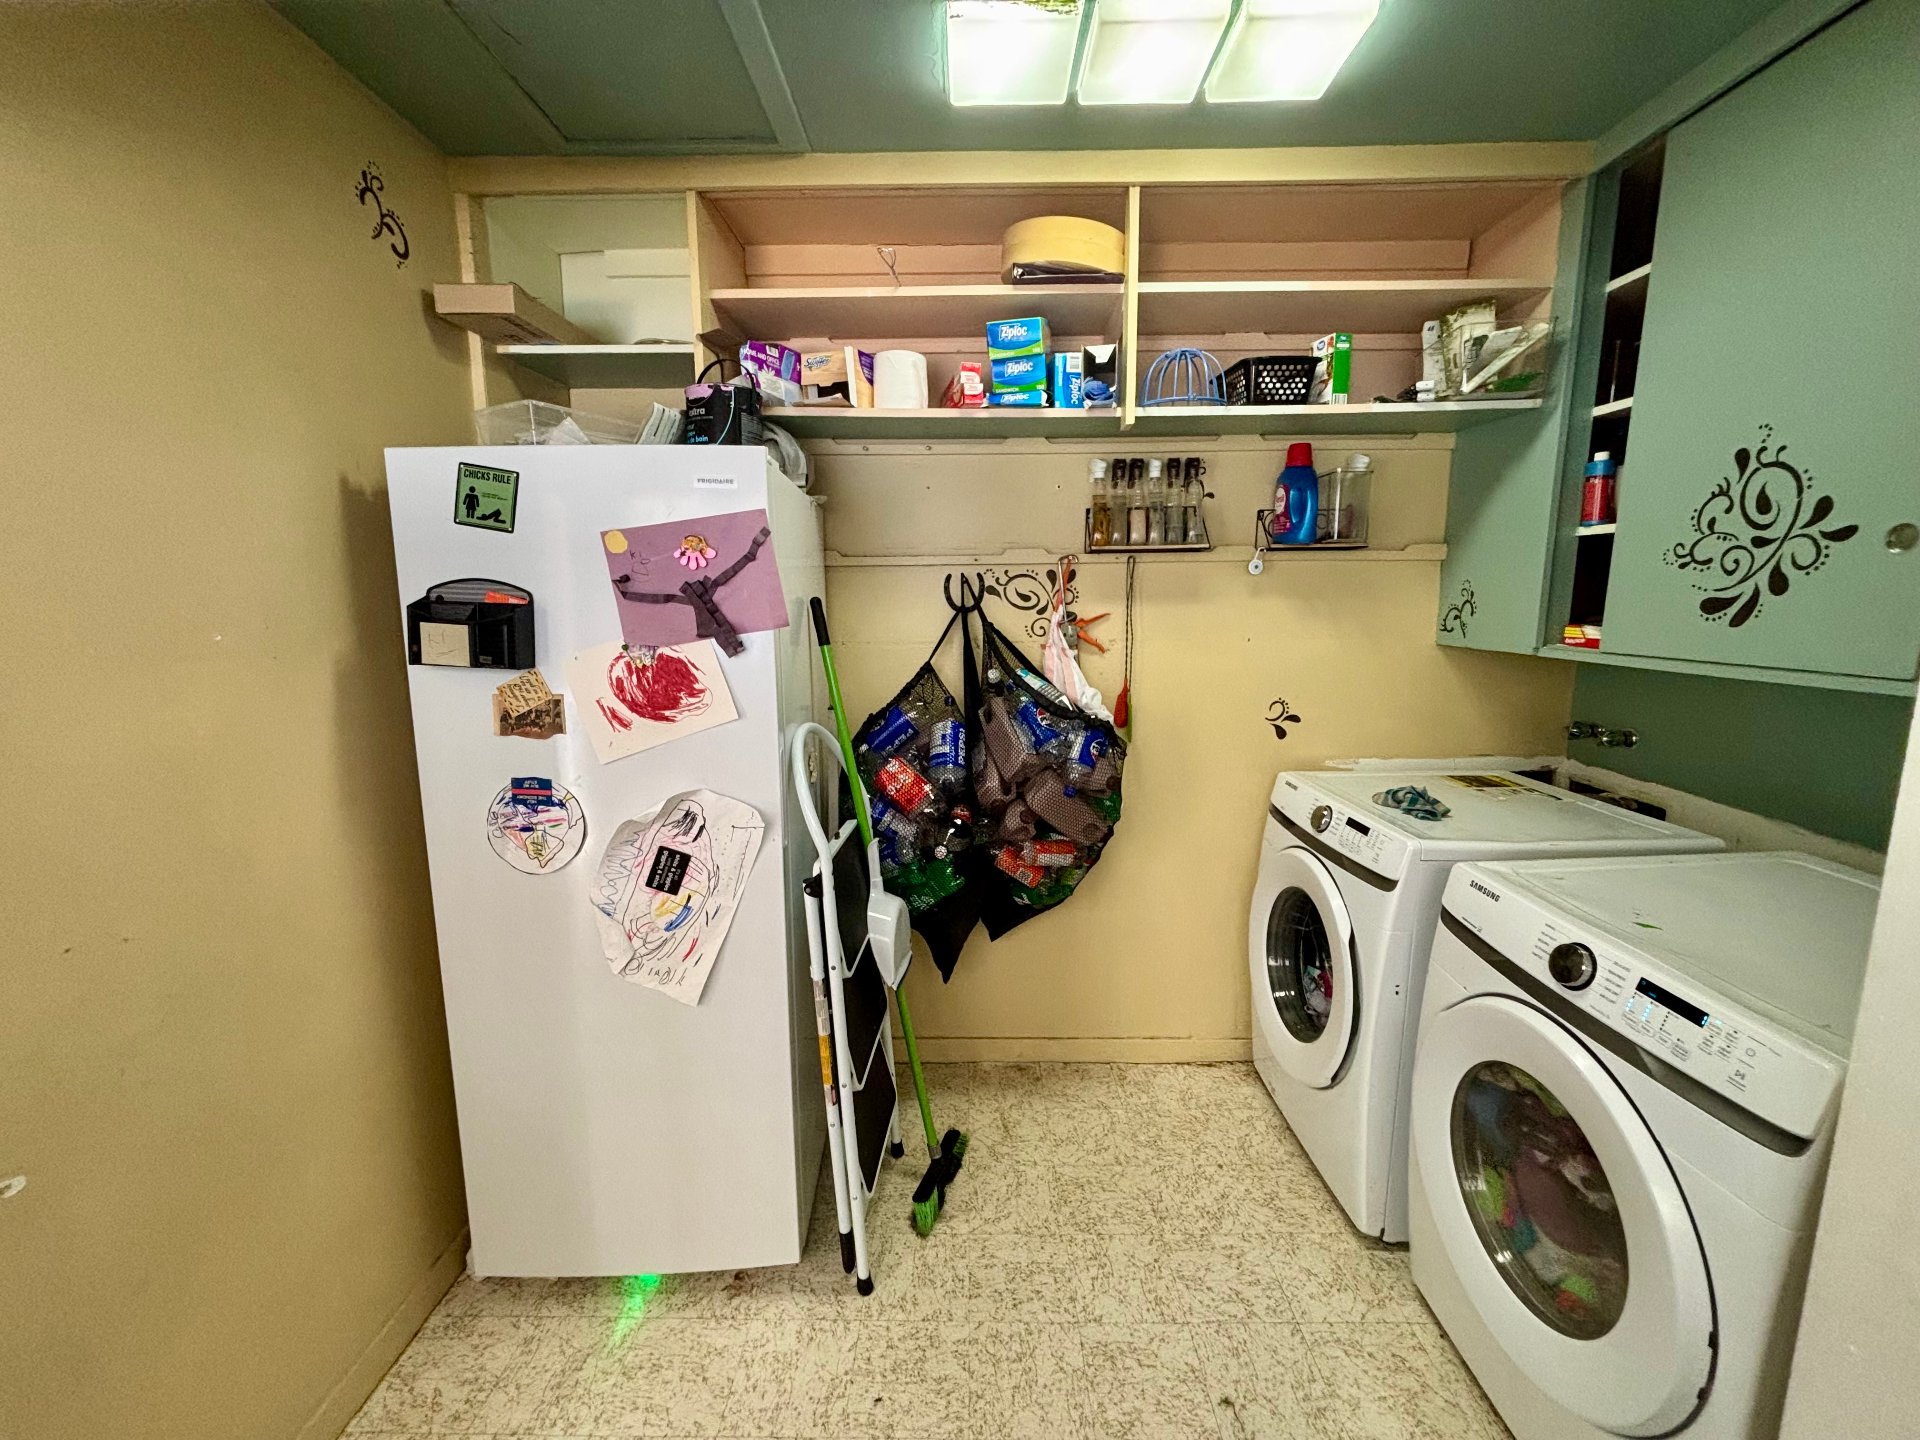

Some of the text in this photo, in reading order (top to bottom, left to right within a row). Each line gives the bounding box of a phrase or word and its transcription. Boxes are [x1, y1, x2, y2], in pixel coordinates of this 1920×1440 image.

[1001, 323, 1028, 340] Ziploc
[1006, 361, 1034, 376] Ziploc
[1002, 392, 1030, 402] Ziploc
[1070, 376, 1082, 405] Ziploc
[463, 468, 512, 485] CHICKS RULE
[957, 727, 967, 765] PEPSI
[1469, 879, 1501, 903] SAMSUNG
